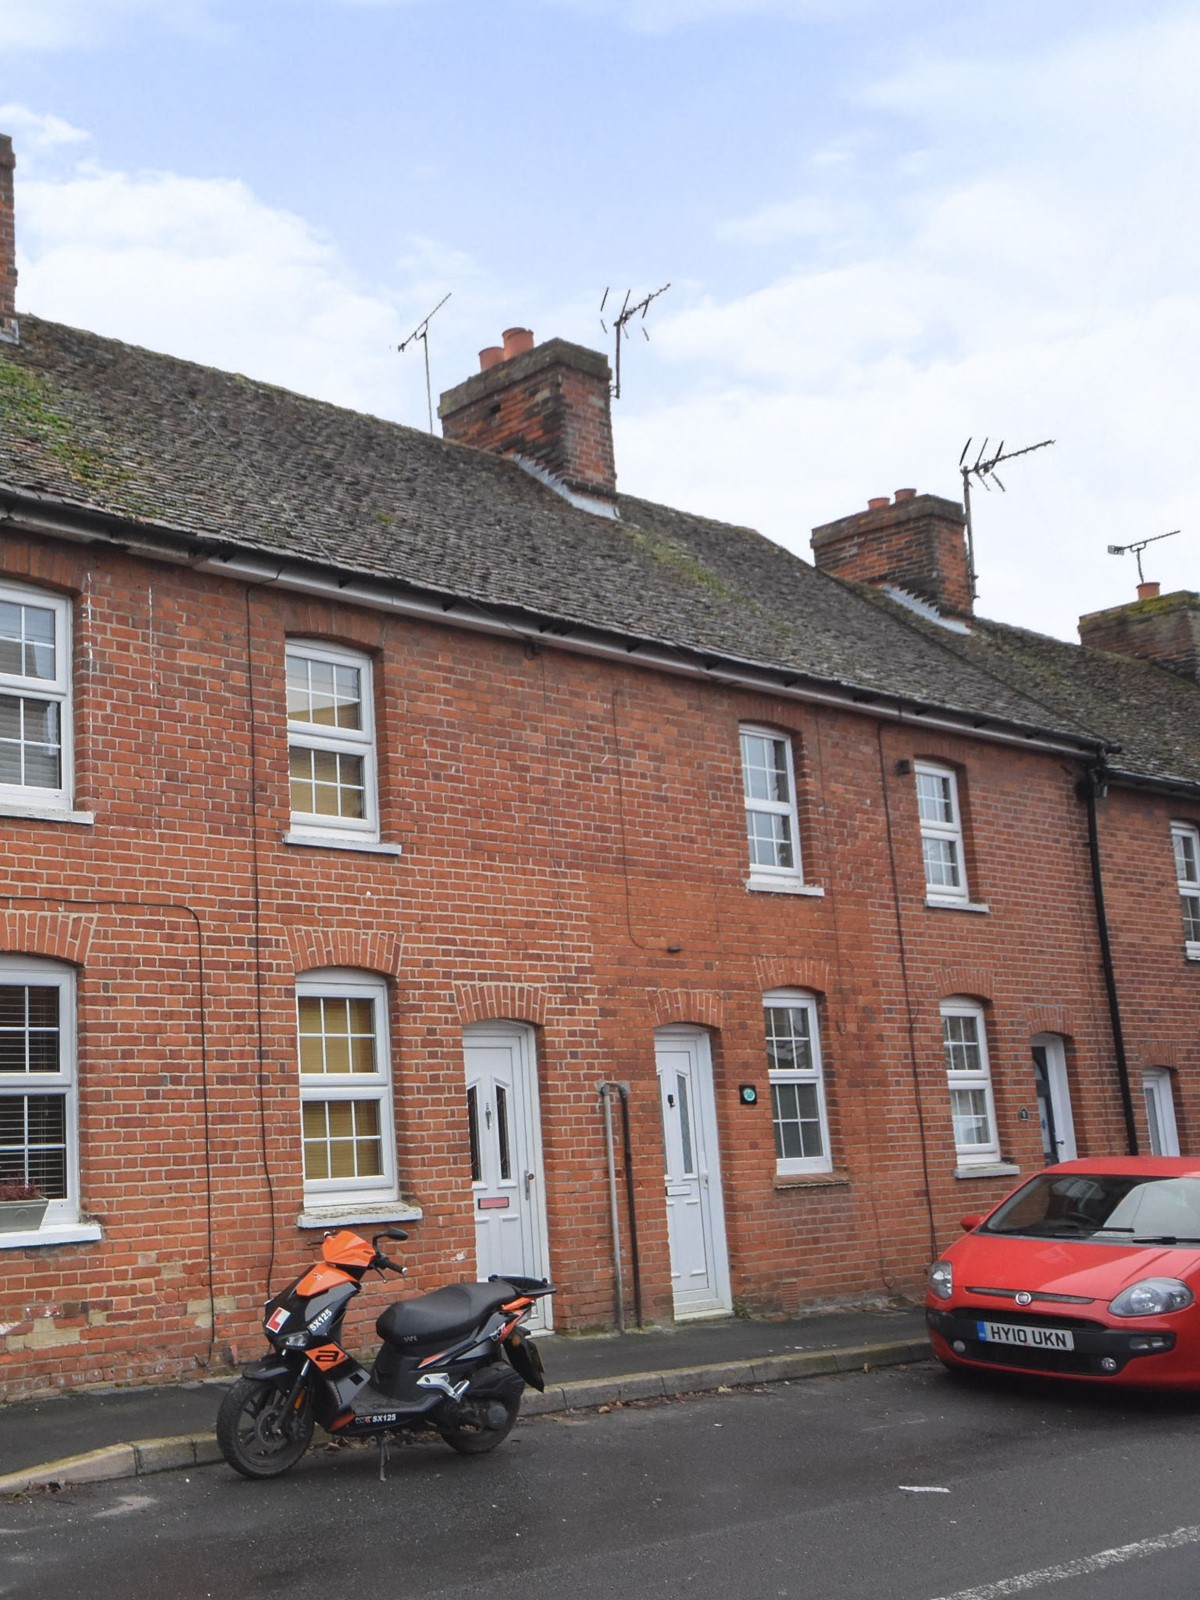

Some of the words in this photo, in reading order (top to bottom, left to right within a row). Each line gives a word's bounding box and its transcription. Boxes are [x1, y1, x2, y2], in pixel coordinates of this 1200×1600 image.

[309, 1309, 332, 1331] SX125
[990, 1325, 1027, 1343] HY10
[1032, 1330, 1067, 1347] UKN
[372, 1413, 397, 1423] SX125
